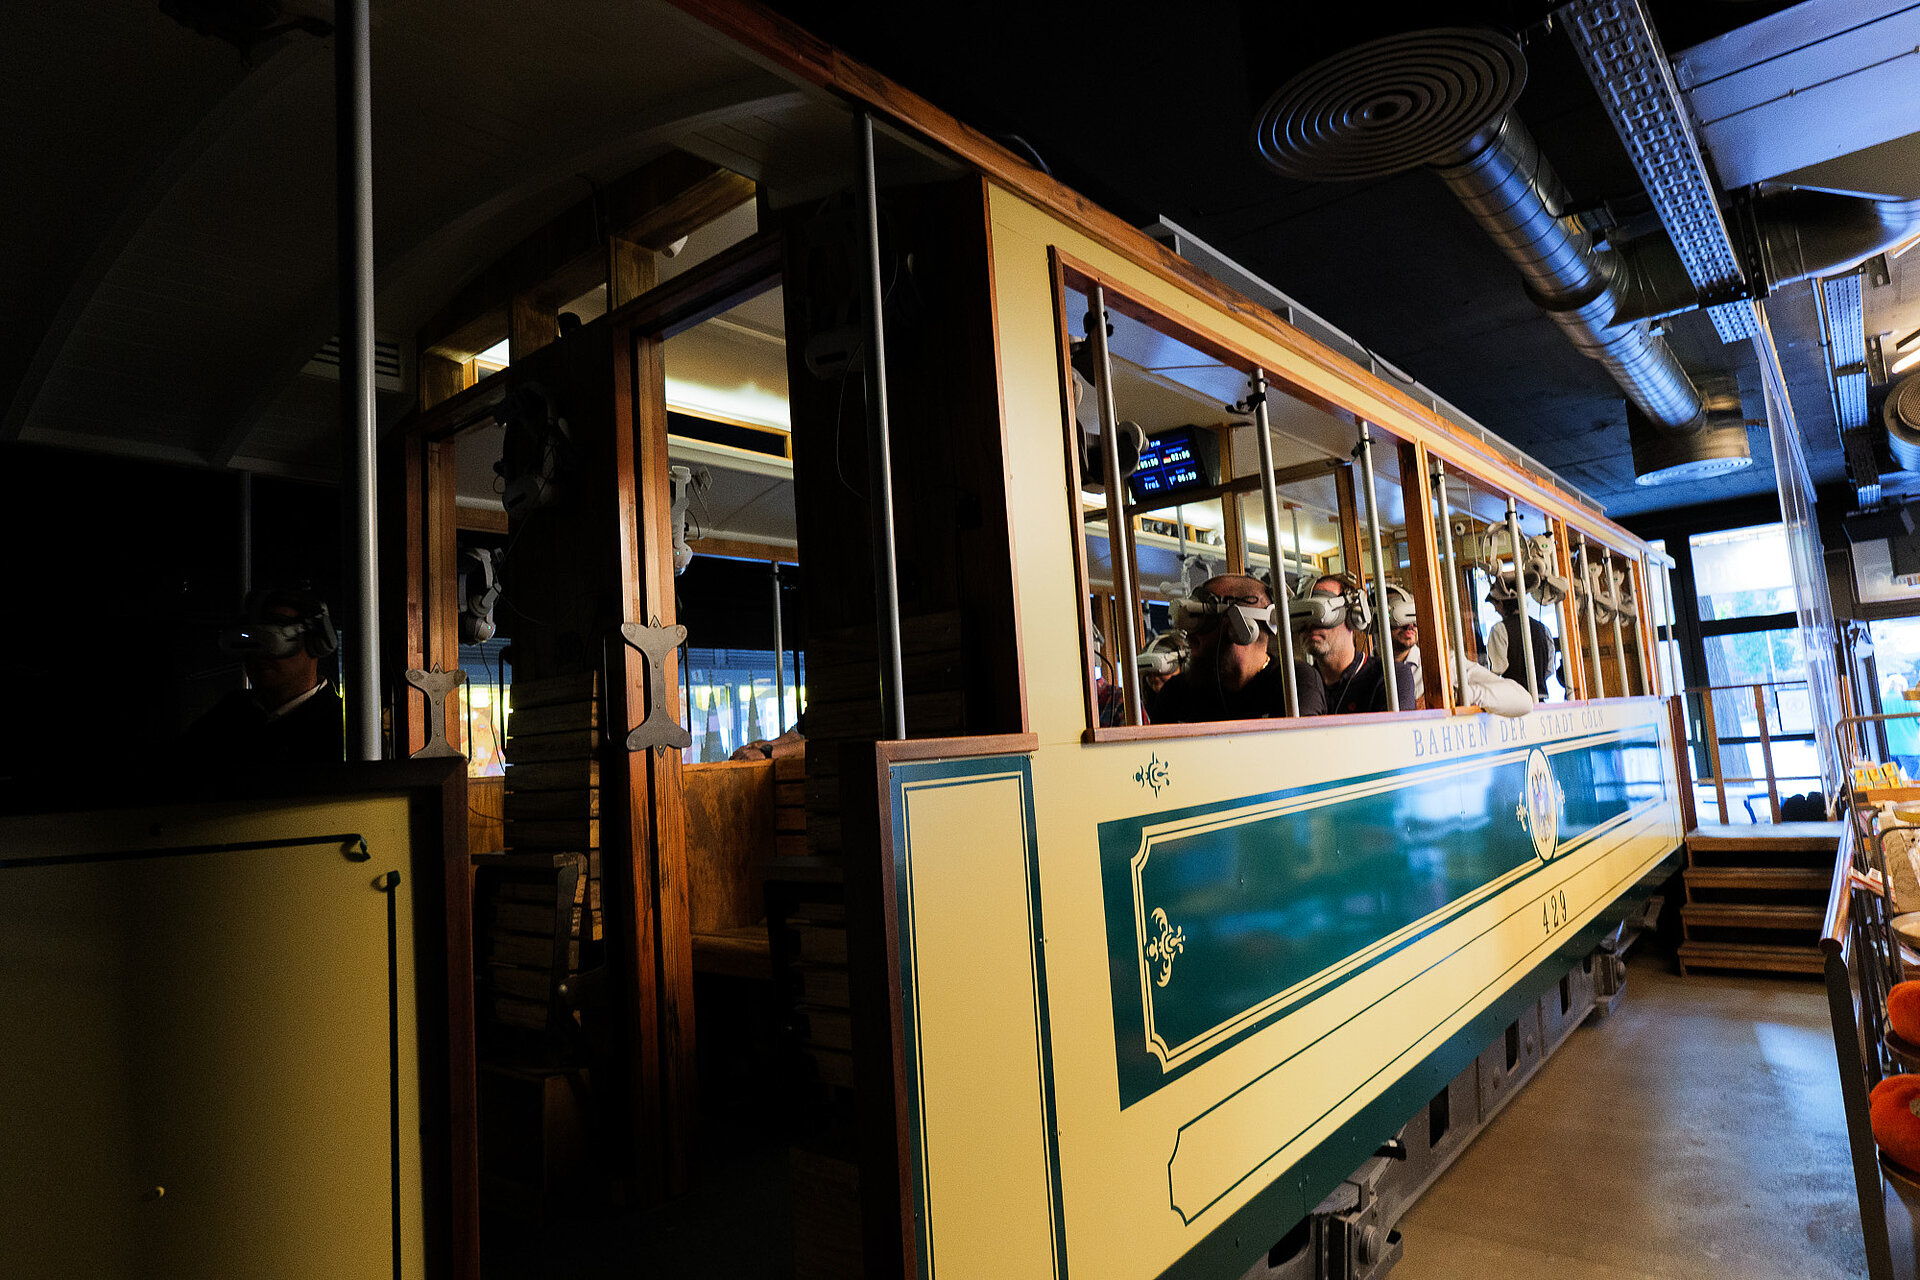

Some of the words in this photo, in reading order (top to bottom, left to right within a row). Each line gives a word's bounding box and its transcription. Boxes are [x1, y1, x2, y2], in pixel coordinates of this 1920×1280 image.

[1413, 721, 1488, 757] BAHNEN
[1500, 717, 1527, 743] DER
[1541, 713, 1575, 737] STADT
[1543, 889, 1567, 935] 429
